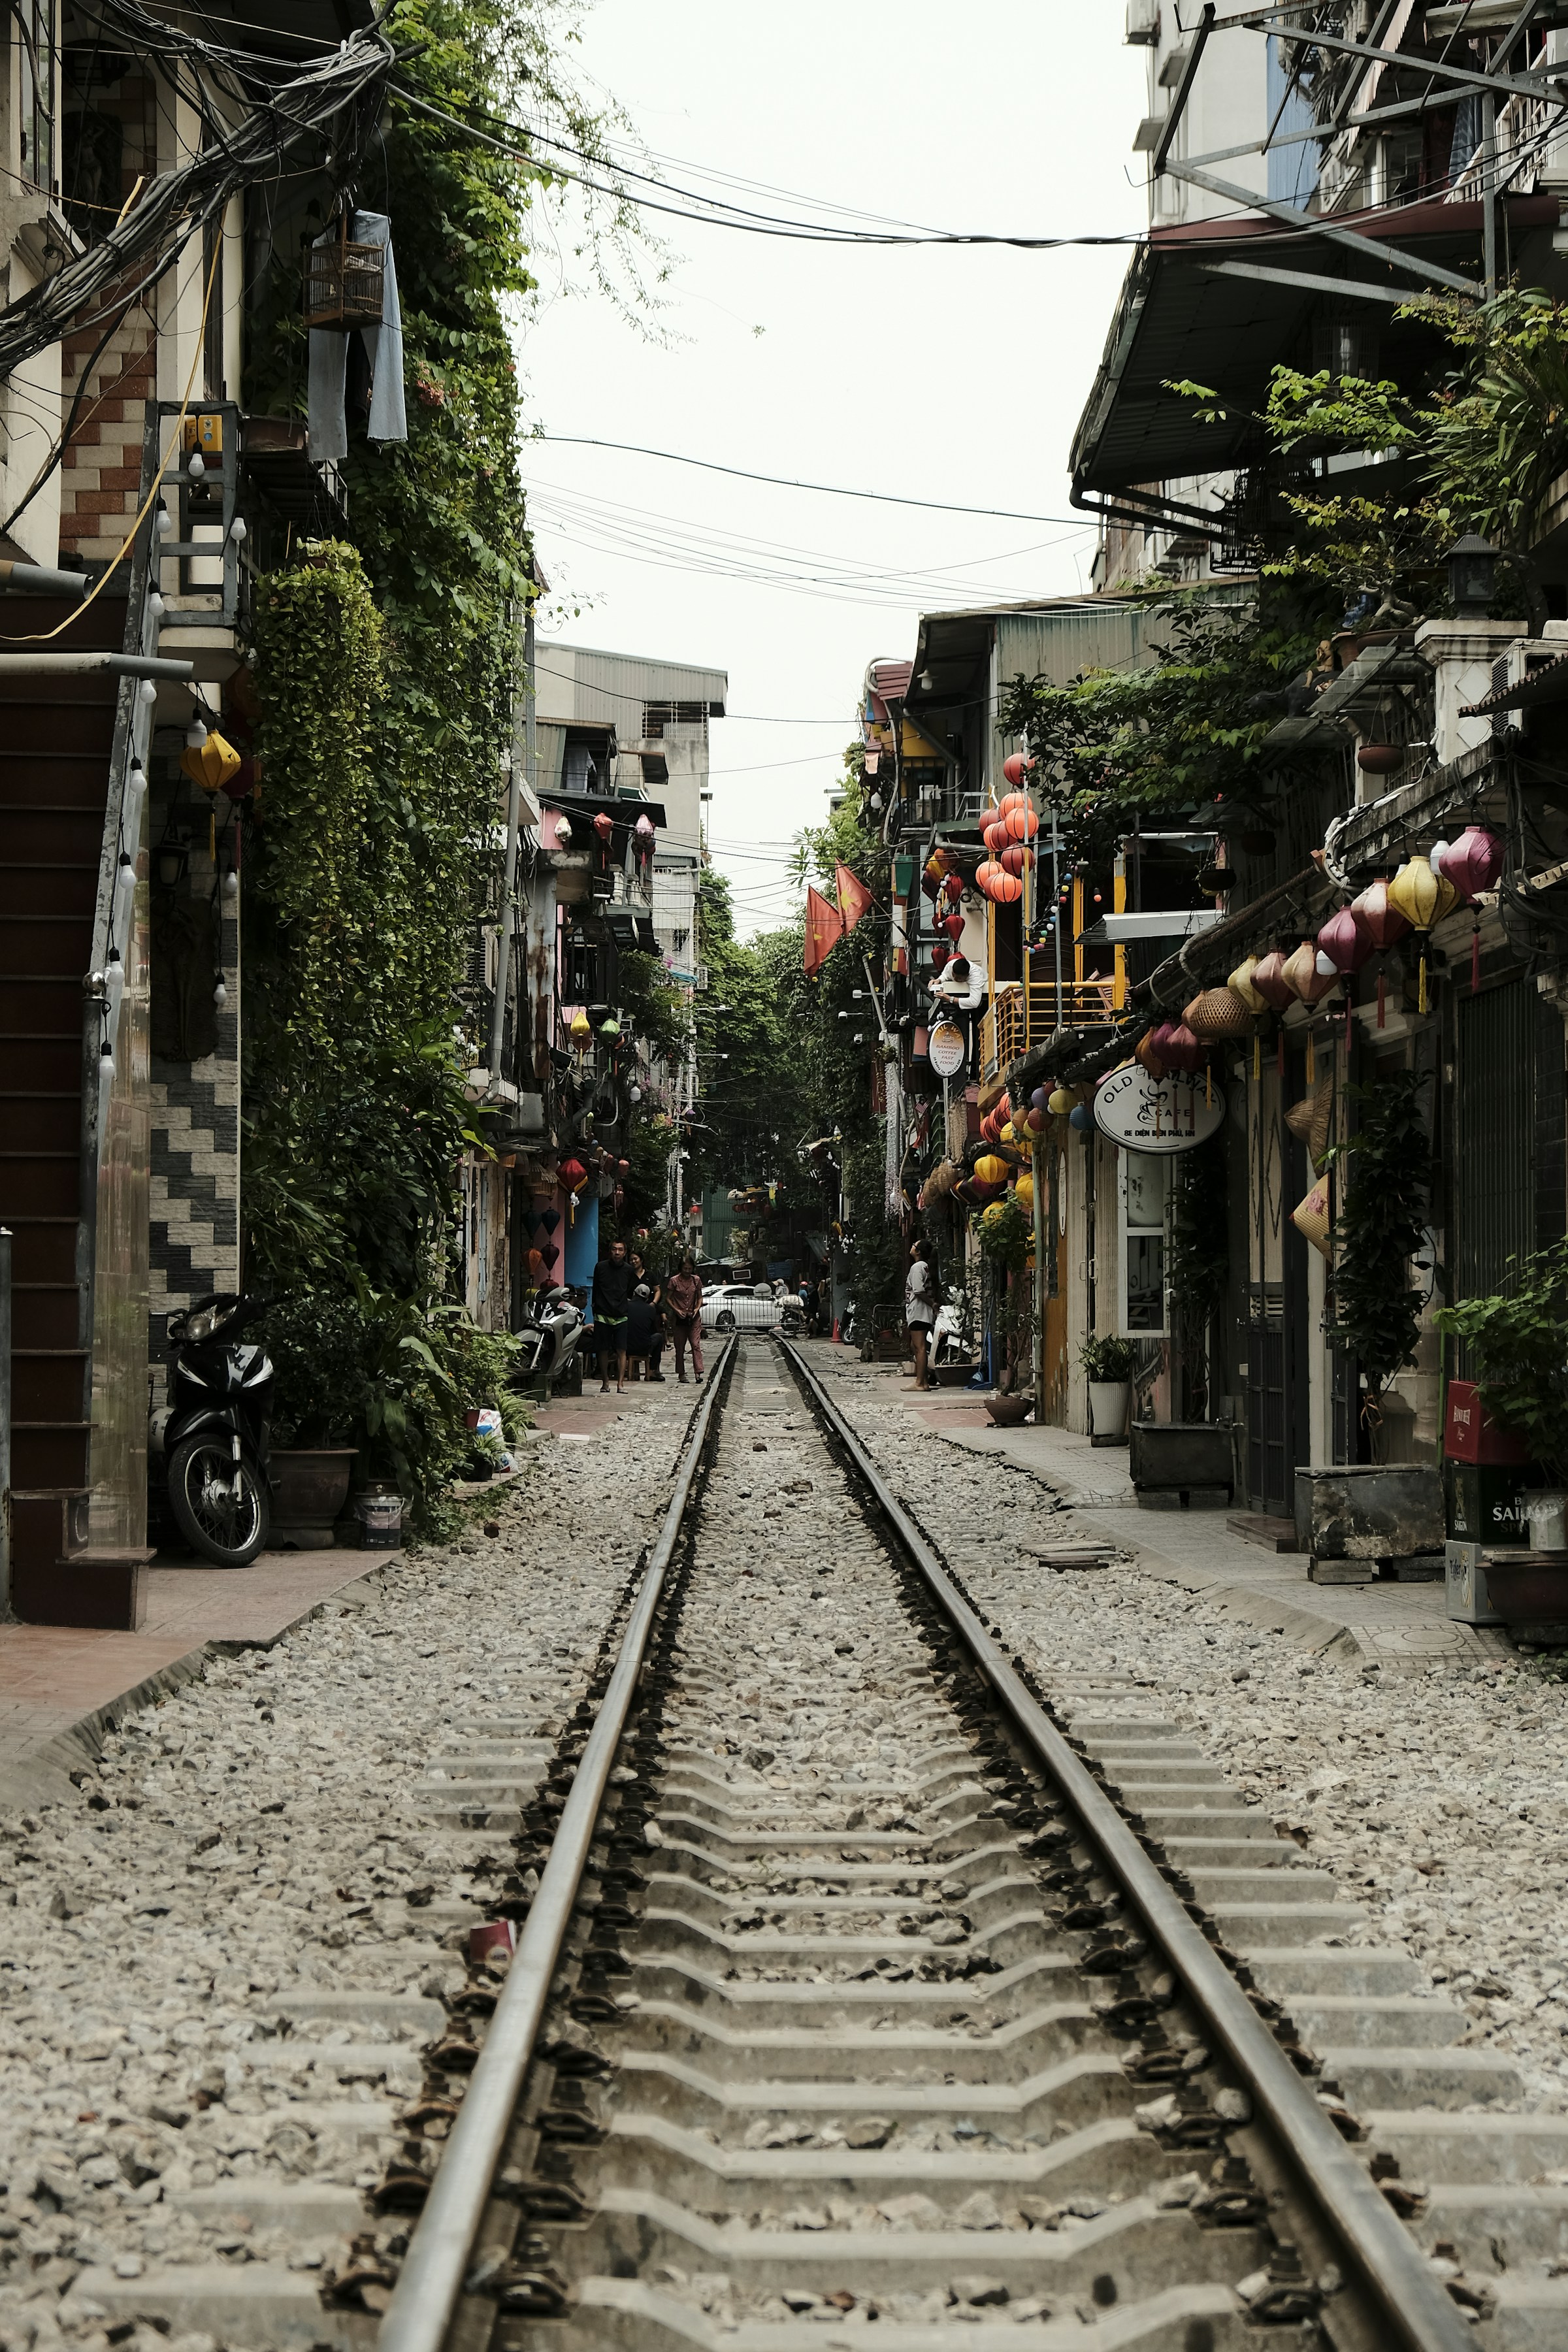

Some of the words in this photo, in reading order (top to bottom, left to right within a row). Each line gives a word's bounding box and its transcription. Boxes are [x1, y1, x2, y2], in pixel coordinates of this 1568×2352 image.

[1103, 1075, 1132, 1103] OLD
[1148, 1069, 1217, 1103] AILWAY
[1454, 1519, 1468, 1531] SAIGON
